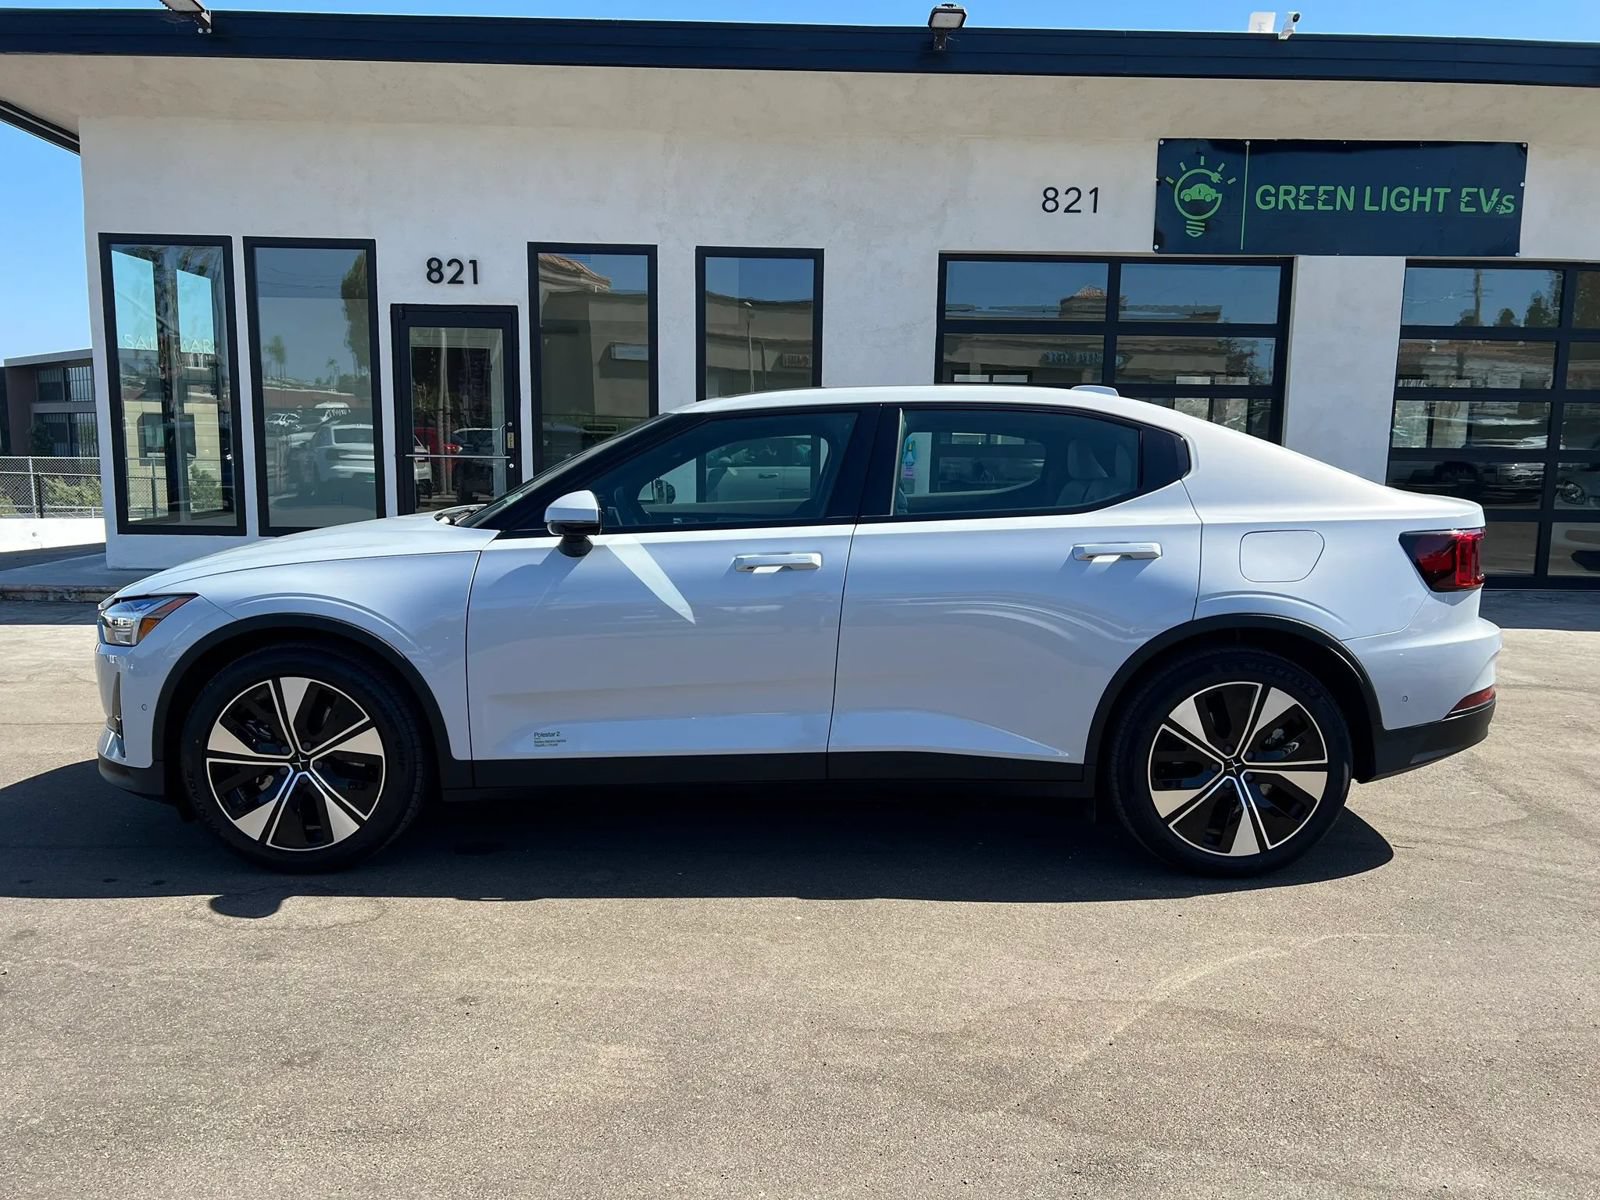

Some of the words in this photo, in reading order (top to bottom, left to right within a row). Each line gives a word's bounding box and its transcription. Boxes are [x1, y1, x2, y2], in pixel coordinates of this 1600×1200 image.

[1042, 187, 1099, 214] 821
[1255, 184, 1355, 212] GREEN
[1364, 186, 1452, 213] LIGHT
[1460, 187, 1515, 215] EVs
[426, 257, 479, 285] 821
